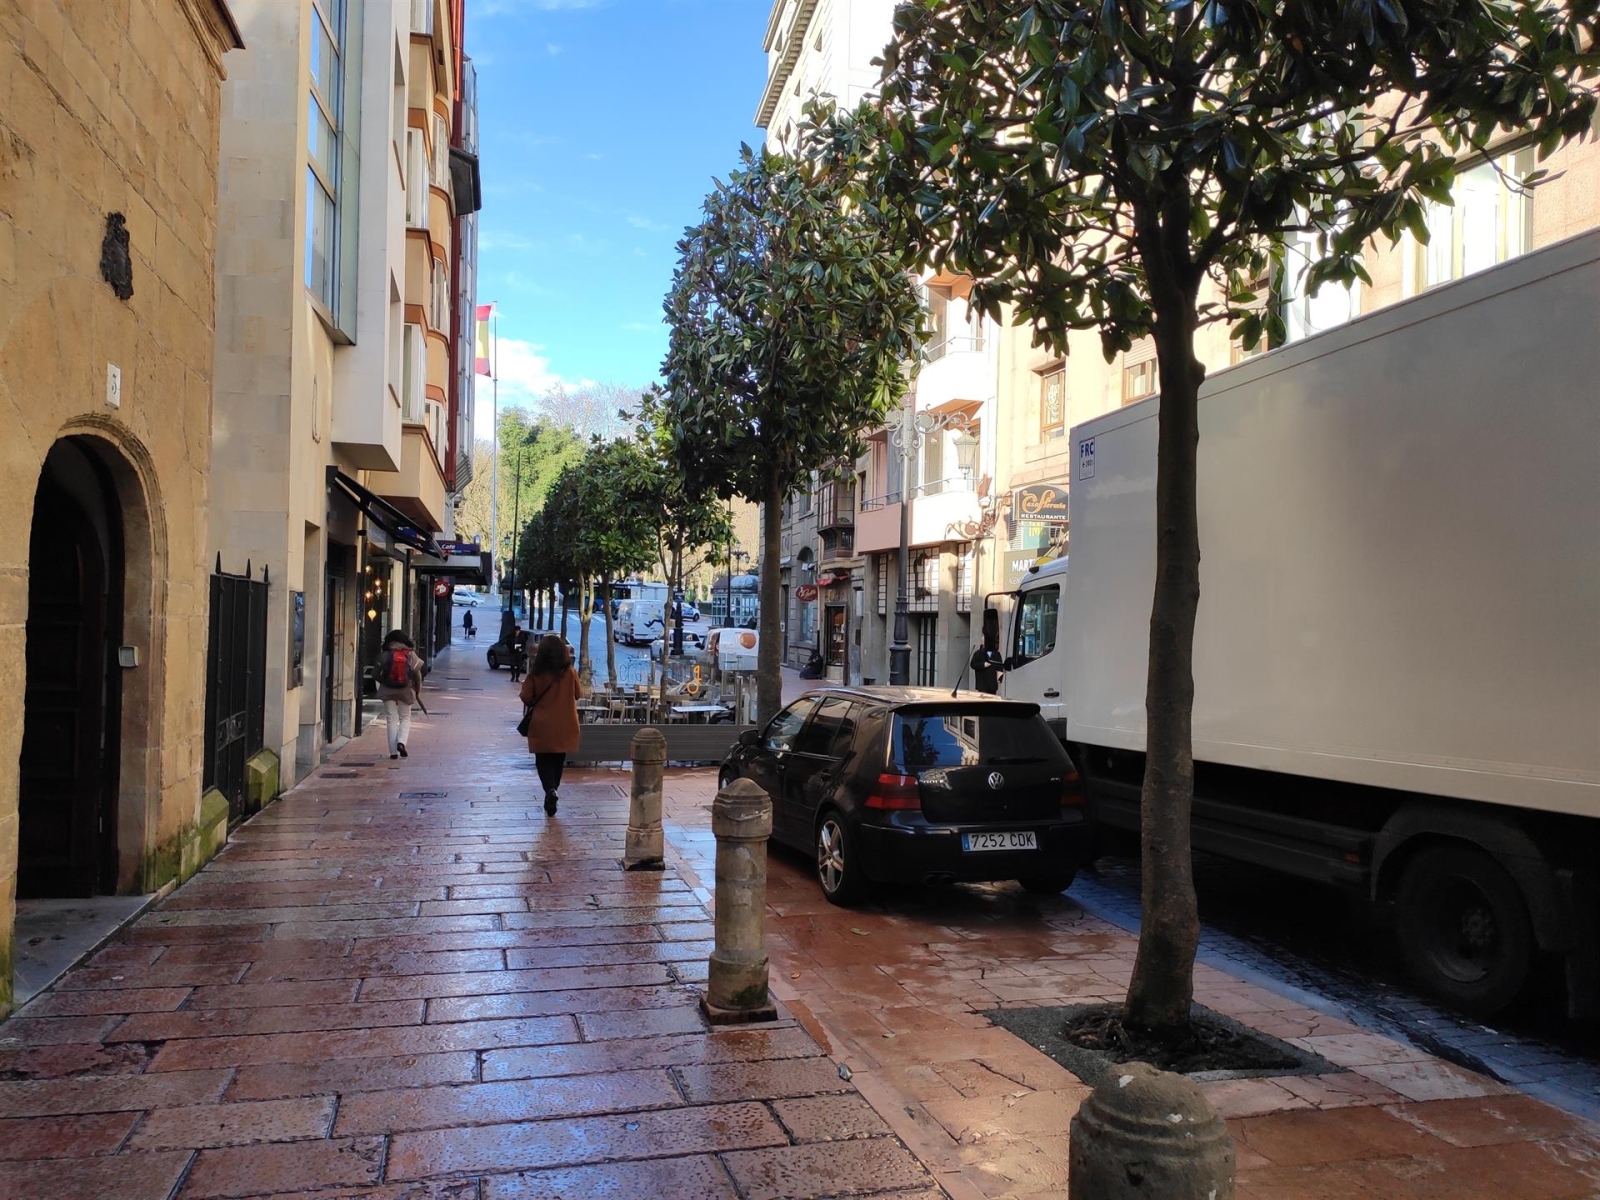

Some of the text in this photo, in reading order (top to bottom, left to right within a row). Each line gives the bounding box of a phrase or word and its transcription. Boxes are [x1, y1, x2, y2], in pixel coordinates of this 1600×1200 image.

[1081, 441, 1094, 458] FRC
[1012, 558, 1036, 572] MART
[971, 833, 1034, 848] 7252 CDK
